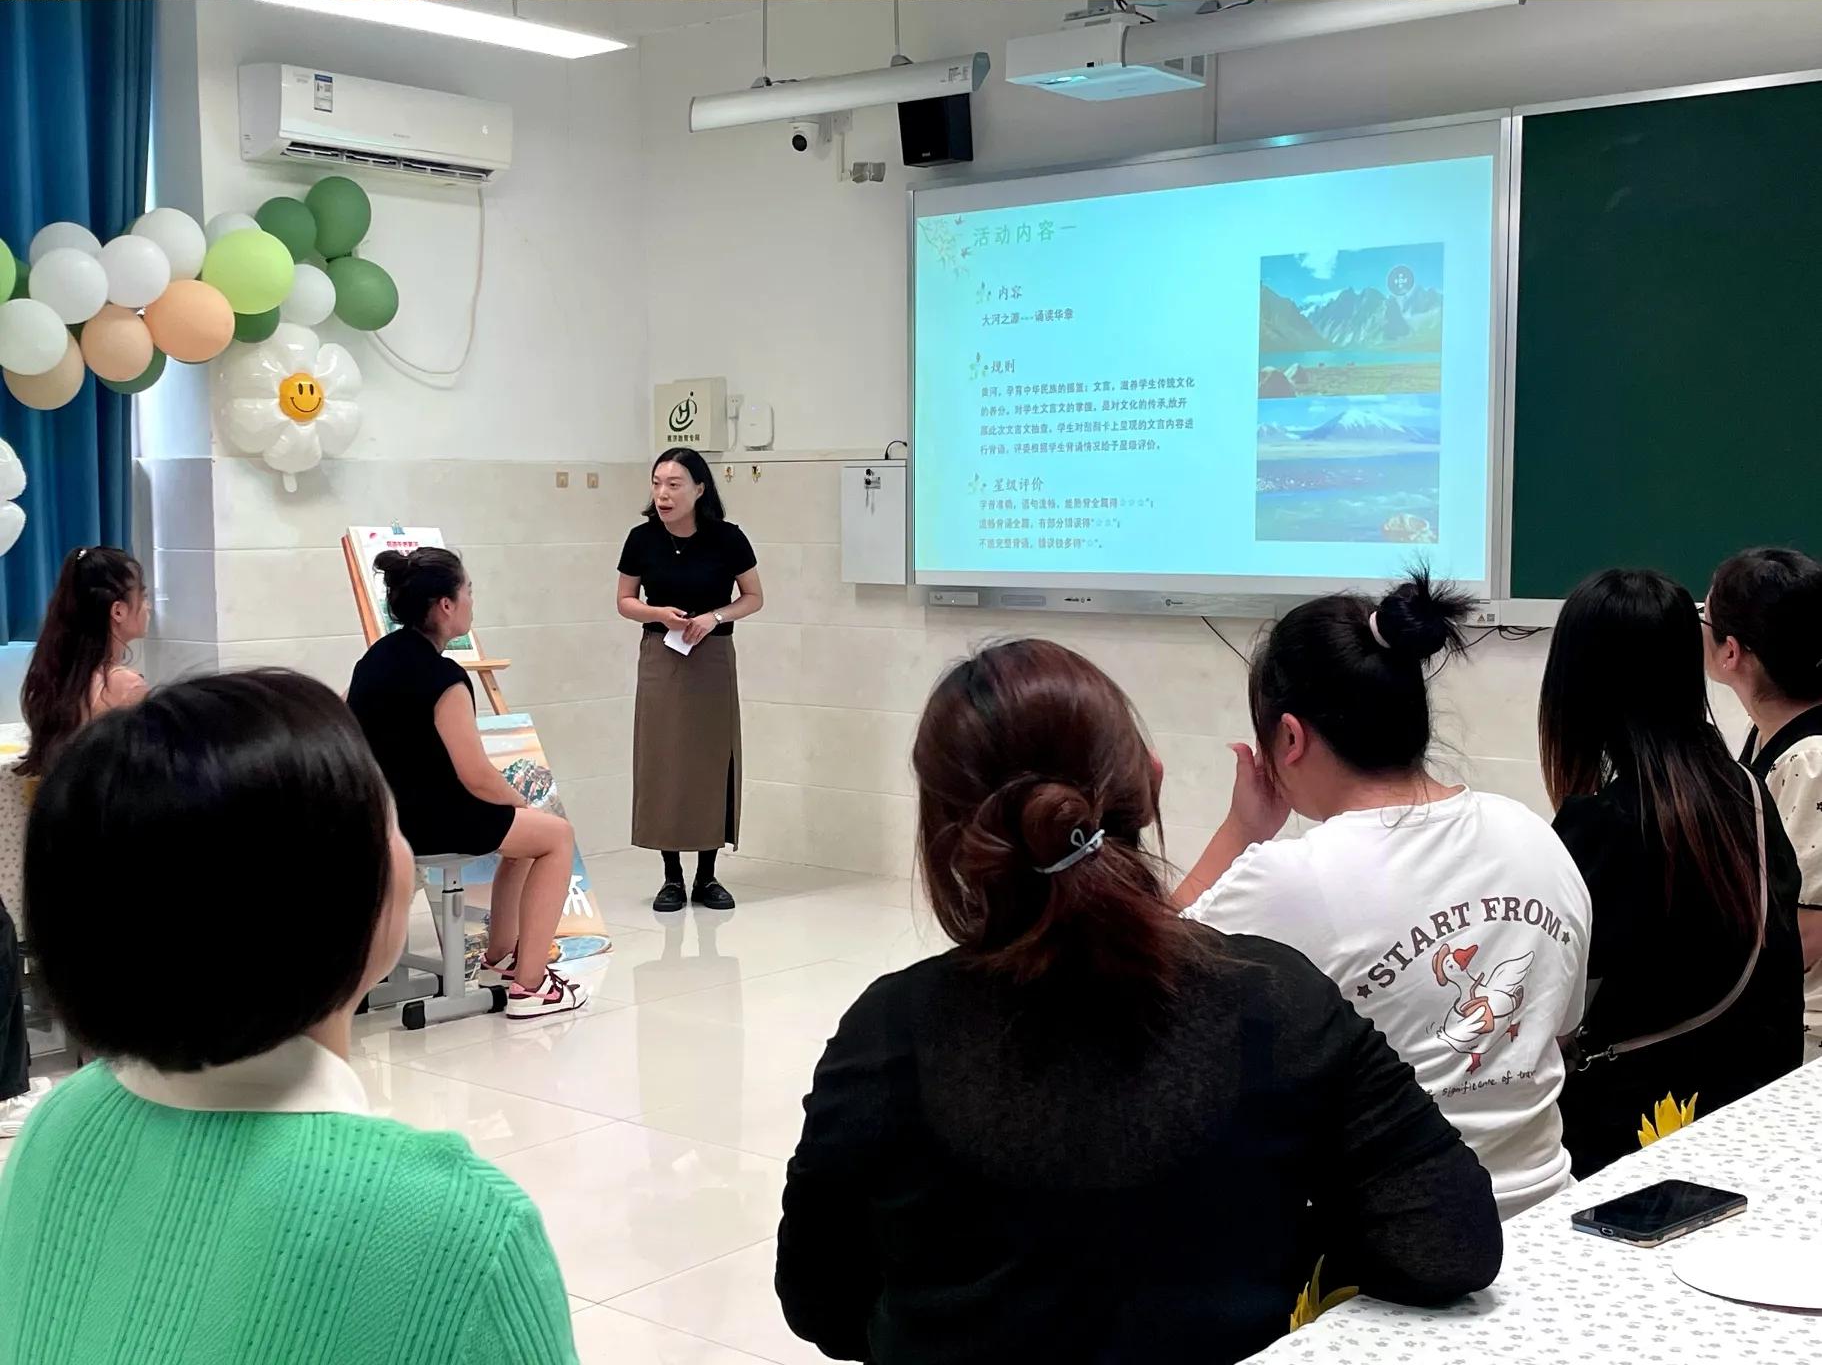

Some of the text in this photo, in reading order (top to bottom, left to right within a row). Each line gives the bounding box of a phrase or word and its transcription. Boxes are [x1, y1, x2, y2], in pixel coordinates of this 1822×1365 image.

[973, 219, 1077, 247] 活动内容一
[998, 284, 1023, 300] 内容
[990, 358, 1015, 373] 规则
[992, 476, 1044, 492] 星级评价
[1367, 896, 1562, 989] START FROM
[1501, 1070, 1513, 1085] of
